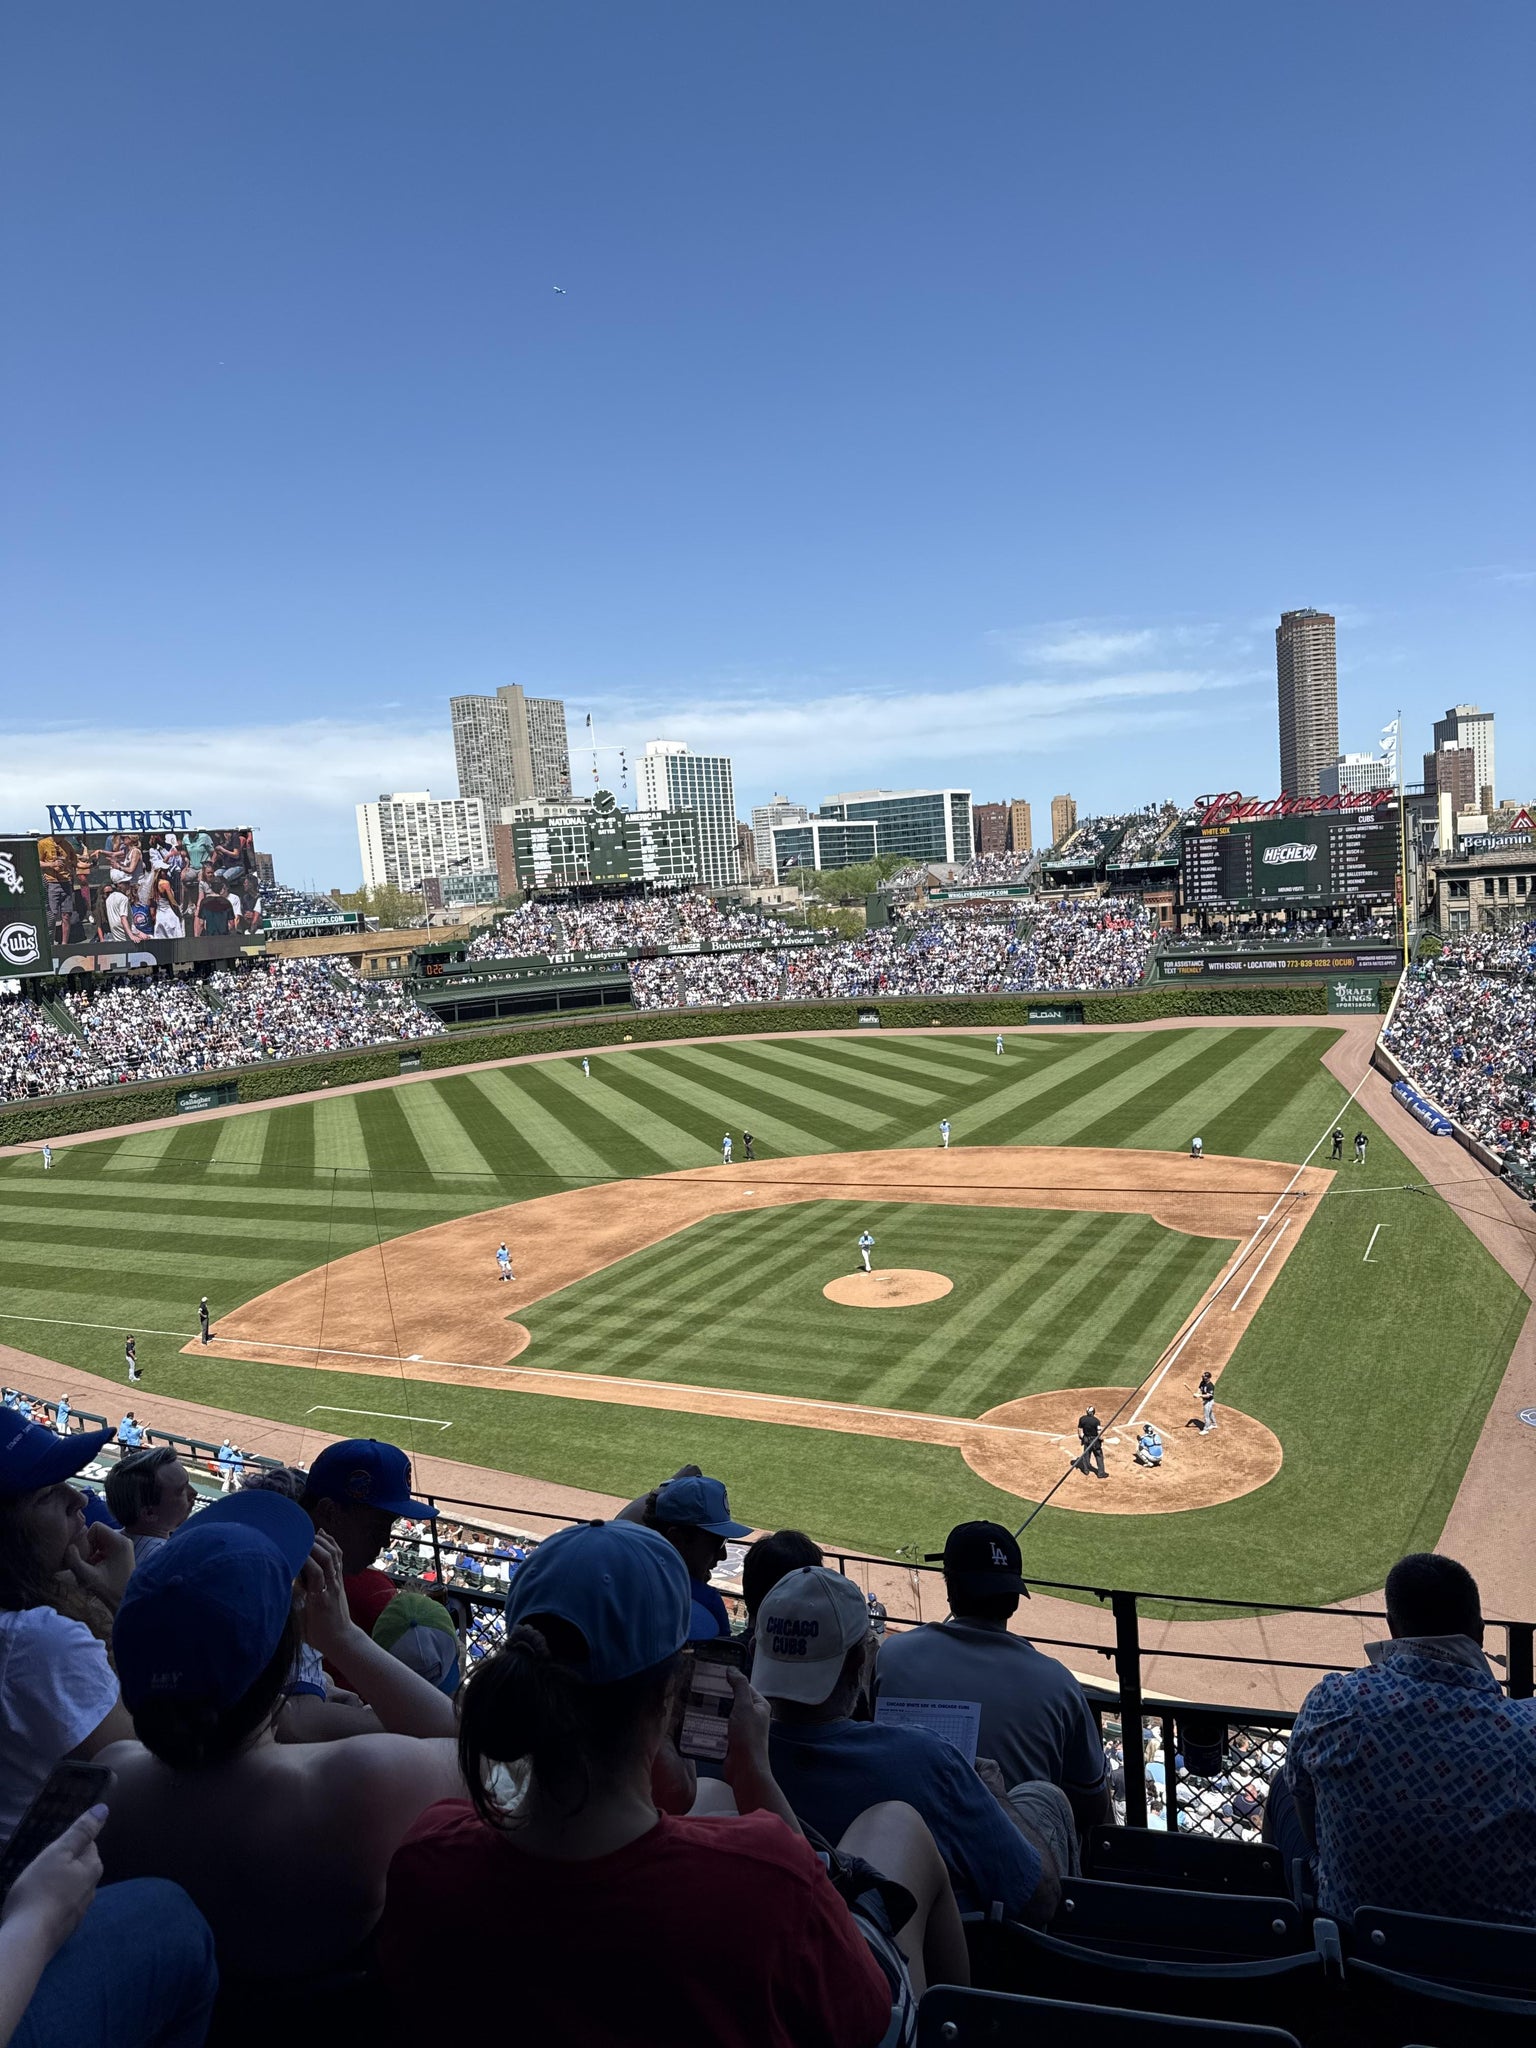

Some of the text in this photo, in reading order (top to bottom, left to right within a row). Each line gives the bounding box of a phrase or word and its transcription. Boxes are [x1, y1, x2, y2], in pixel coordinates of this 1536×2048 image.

[1194, 785, 1394, 826] Budweiser
[46, 804, 192, 832] WINTRUST
[548, 817, 587, 826] NATIONAL
[625, 811, 662, 821] AMERICAN
[1358, 814, 1375, 823] CUBS
[1201, 828, 1219, 836] WHITE
[1464, 832, 1532, 849] Benjamin
[1263, 845, 1315, 862] HI-CHEW
[270, 916, 345, 928] WRIGLEYROOFTOPS.COM
[668, 942, 700, 951] GRAINGER
[781, 936, 814, 946] Advocate
[547, 953, 575, 964] YETI
[590, 950, 628, 960] tastytrade
[1247, 960, 1278, 969] LOCATION
[1287, 960, 1330, 968] 773-839-0282
[1336, 986, 1374, 997] DRAFT
[180, 1096, 211, 1106] Gallagher
[989, 1542, 1008, 1566] LA
[766, 1616, 819, 1638] CHICAGO
[773, 1636, 808, 1656] CUBS
